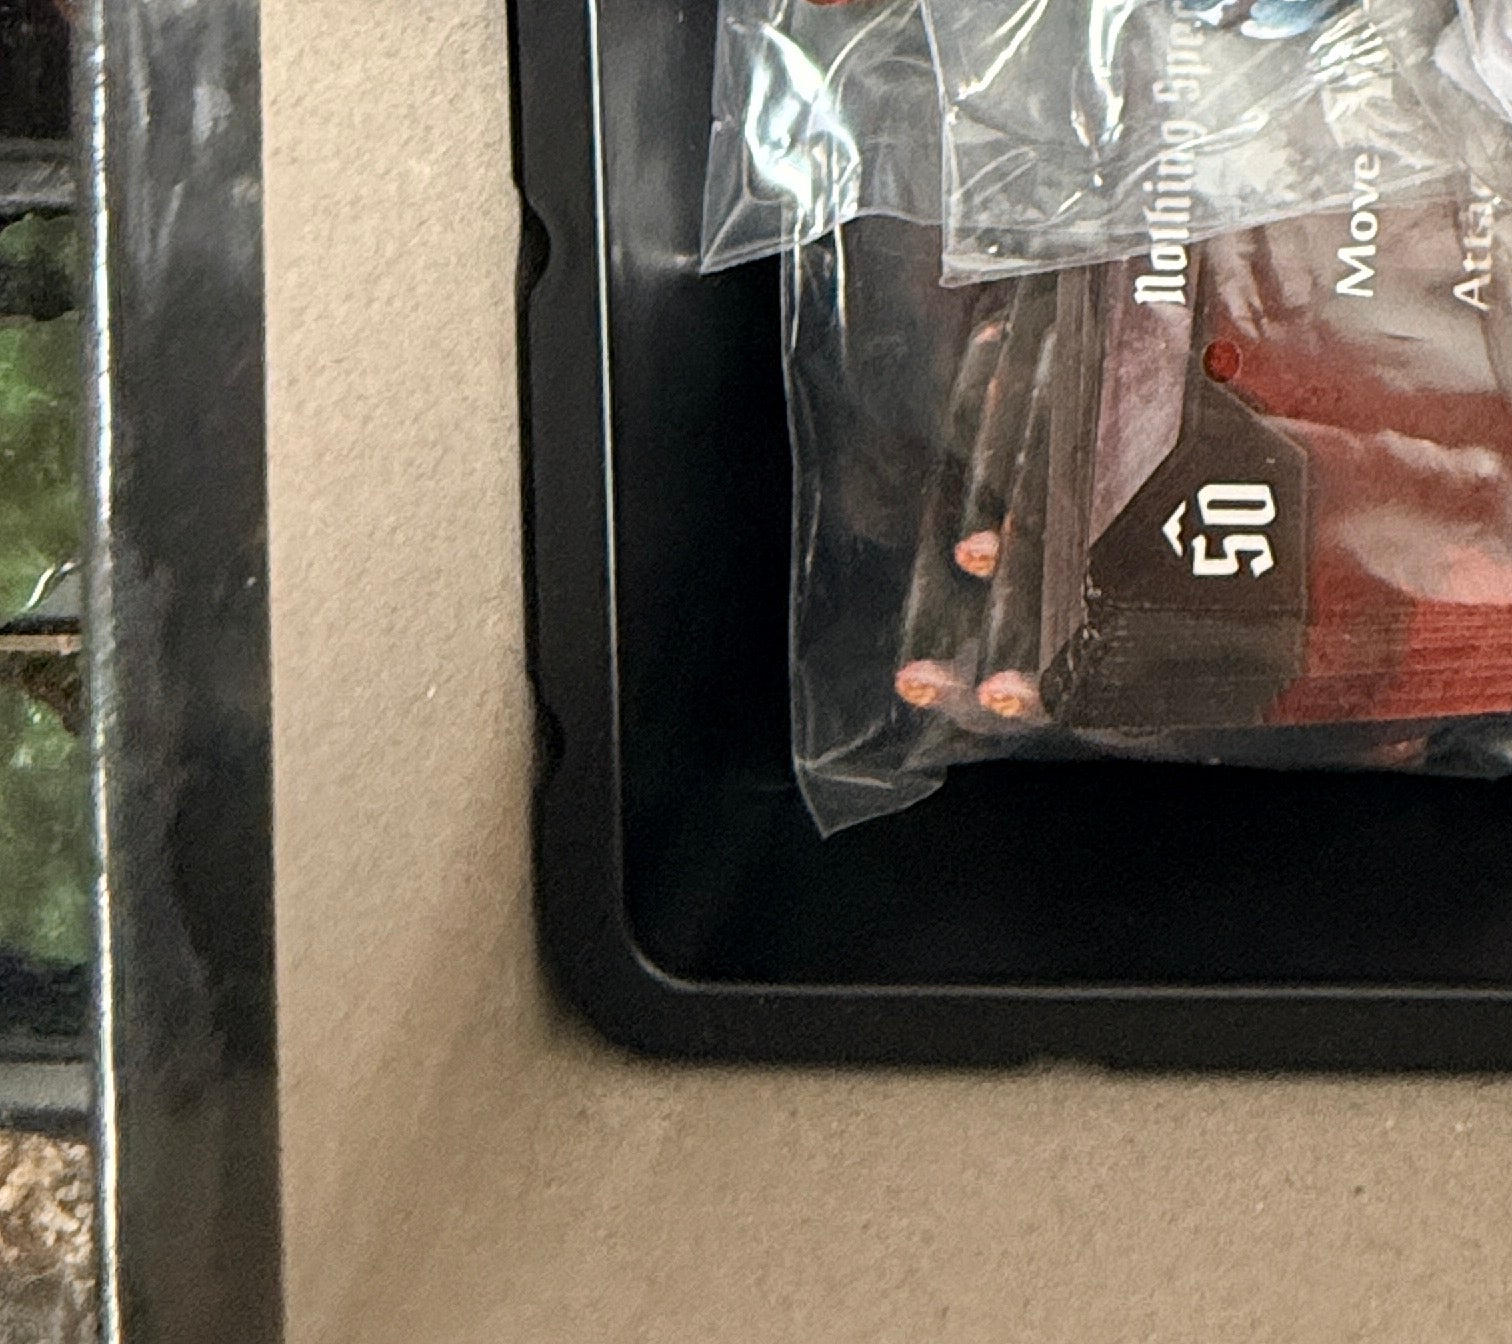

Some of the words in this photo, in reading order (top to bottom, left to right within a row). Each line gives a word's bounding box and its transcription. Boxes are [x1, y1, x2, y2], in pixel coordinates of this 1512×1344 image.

[1153, 0, 1211, 102] Spec
[1133, 120, 1207, 303] Nothing
[1336, 153, 1381, 298] Move
[1452, 173, 1494, 311] Attac
[1191, 482, 1280, 578] 50
